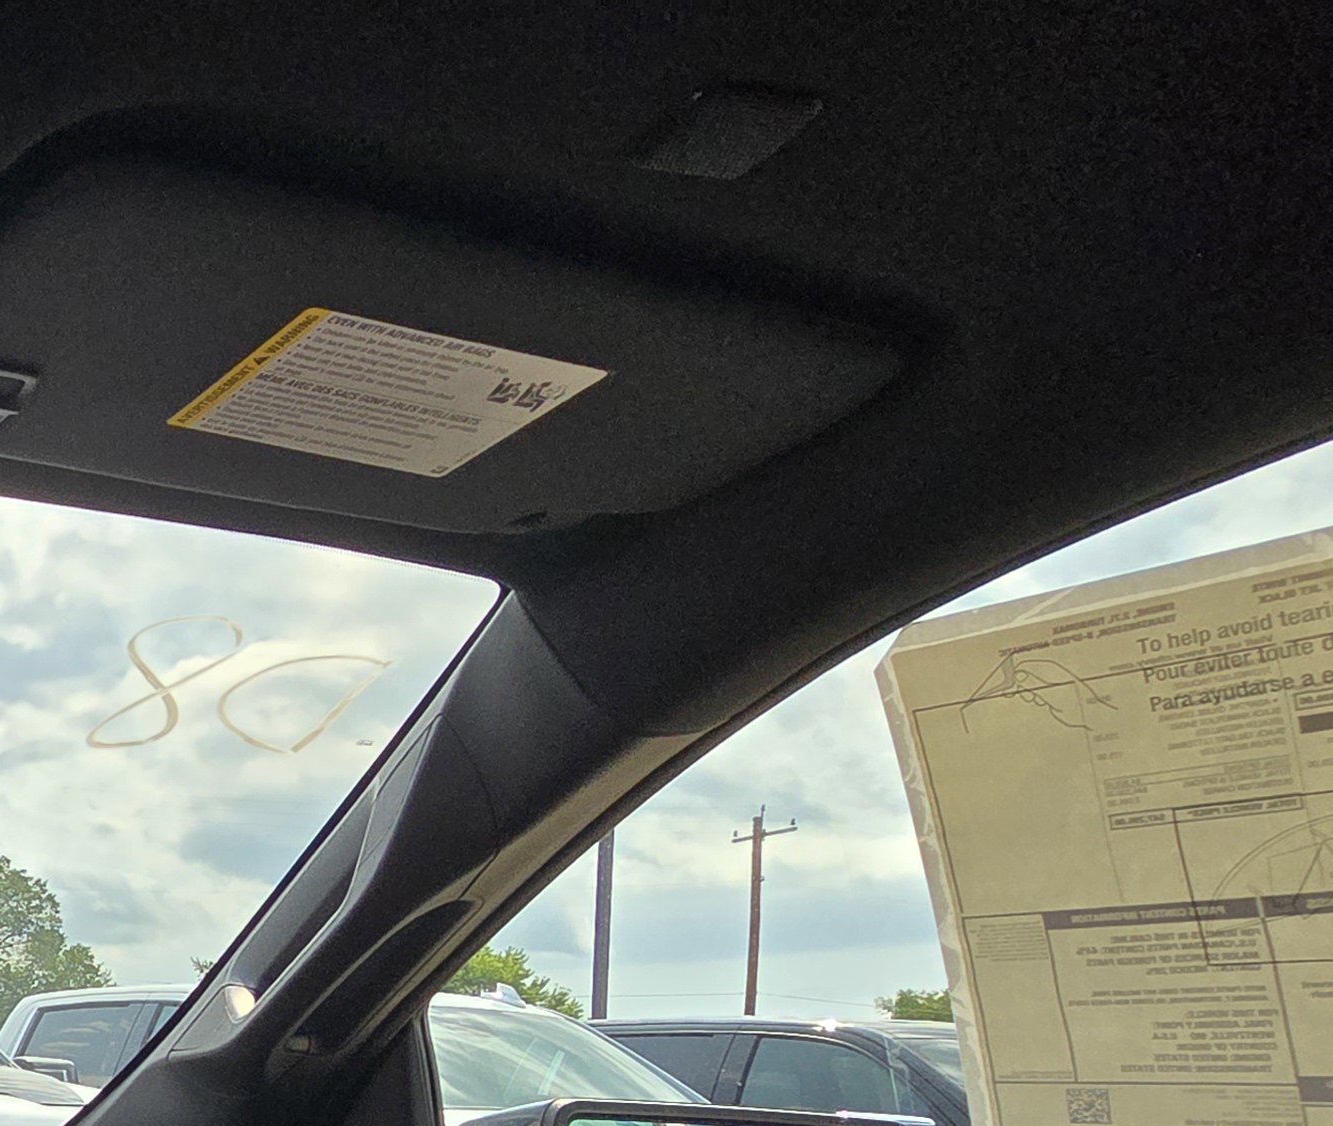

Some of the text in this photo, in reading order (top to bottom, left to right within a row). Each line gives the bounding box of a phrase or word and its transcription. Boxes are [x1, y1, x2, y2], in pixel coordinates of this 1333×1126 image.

[266, 314, 319, 355] WARNING
[1137, 600, 1333, 654] To help avoid teari
[1142, 666, 1190, 683] Pour
[1257, 640, 1314, 663] toute
[1149, 695, 1193, 712] Para
[1199, 677, 1295, 705] ayudarse
[1301, 673, 1314, 687] a
